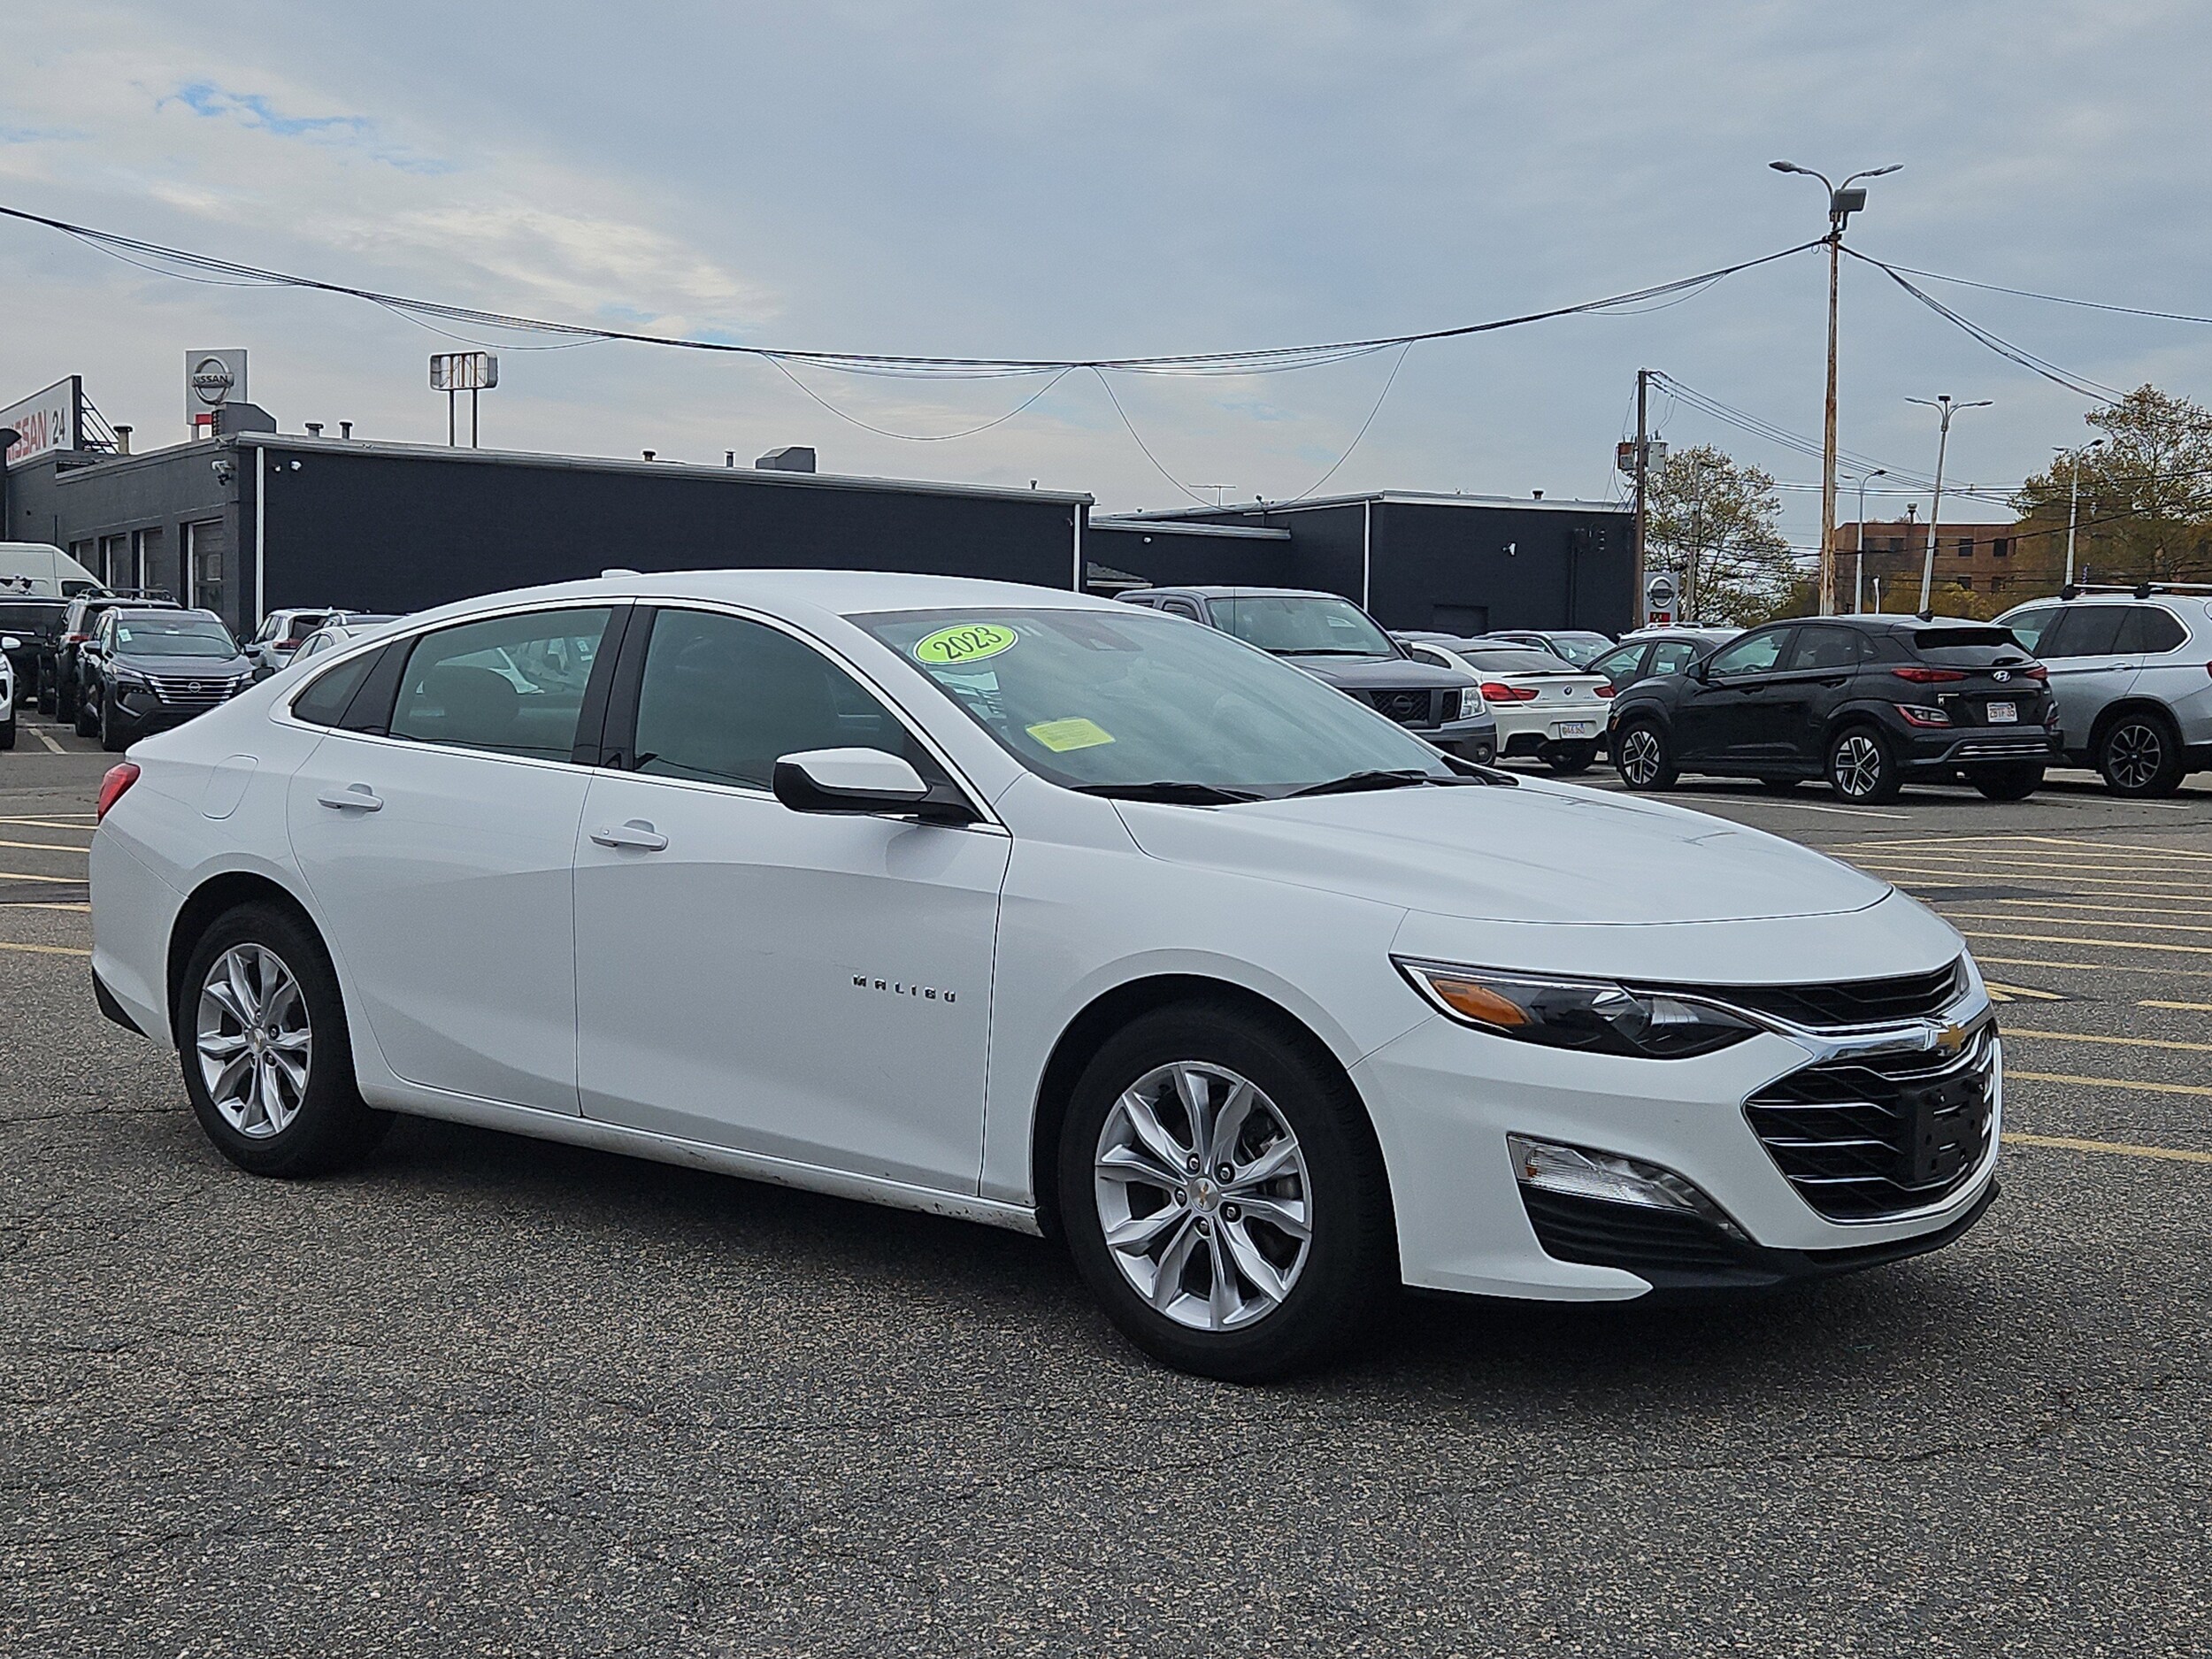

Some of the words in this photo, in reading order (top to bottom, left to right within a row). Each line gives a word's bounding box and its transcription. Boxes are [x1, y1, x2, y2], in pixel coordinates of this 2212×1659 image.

[52, 407, 65, 445] 24
[933, 626, 1002, 660] 2023
[852, 974, 956, 1003] MALIBU
